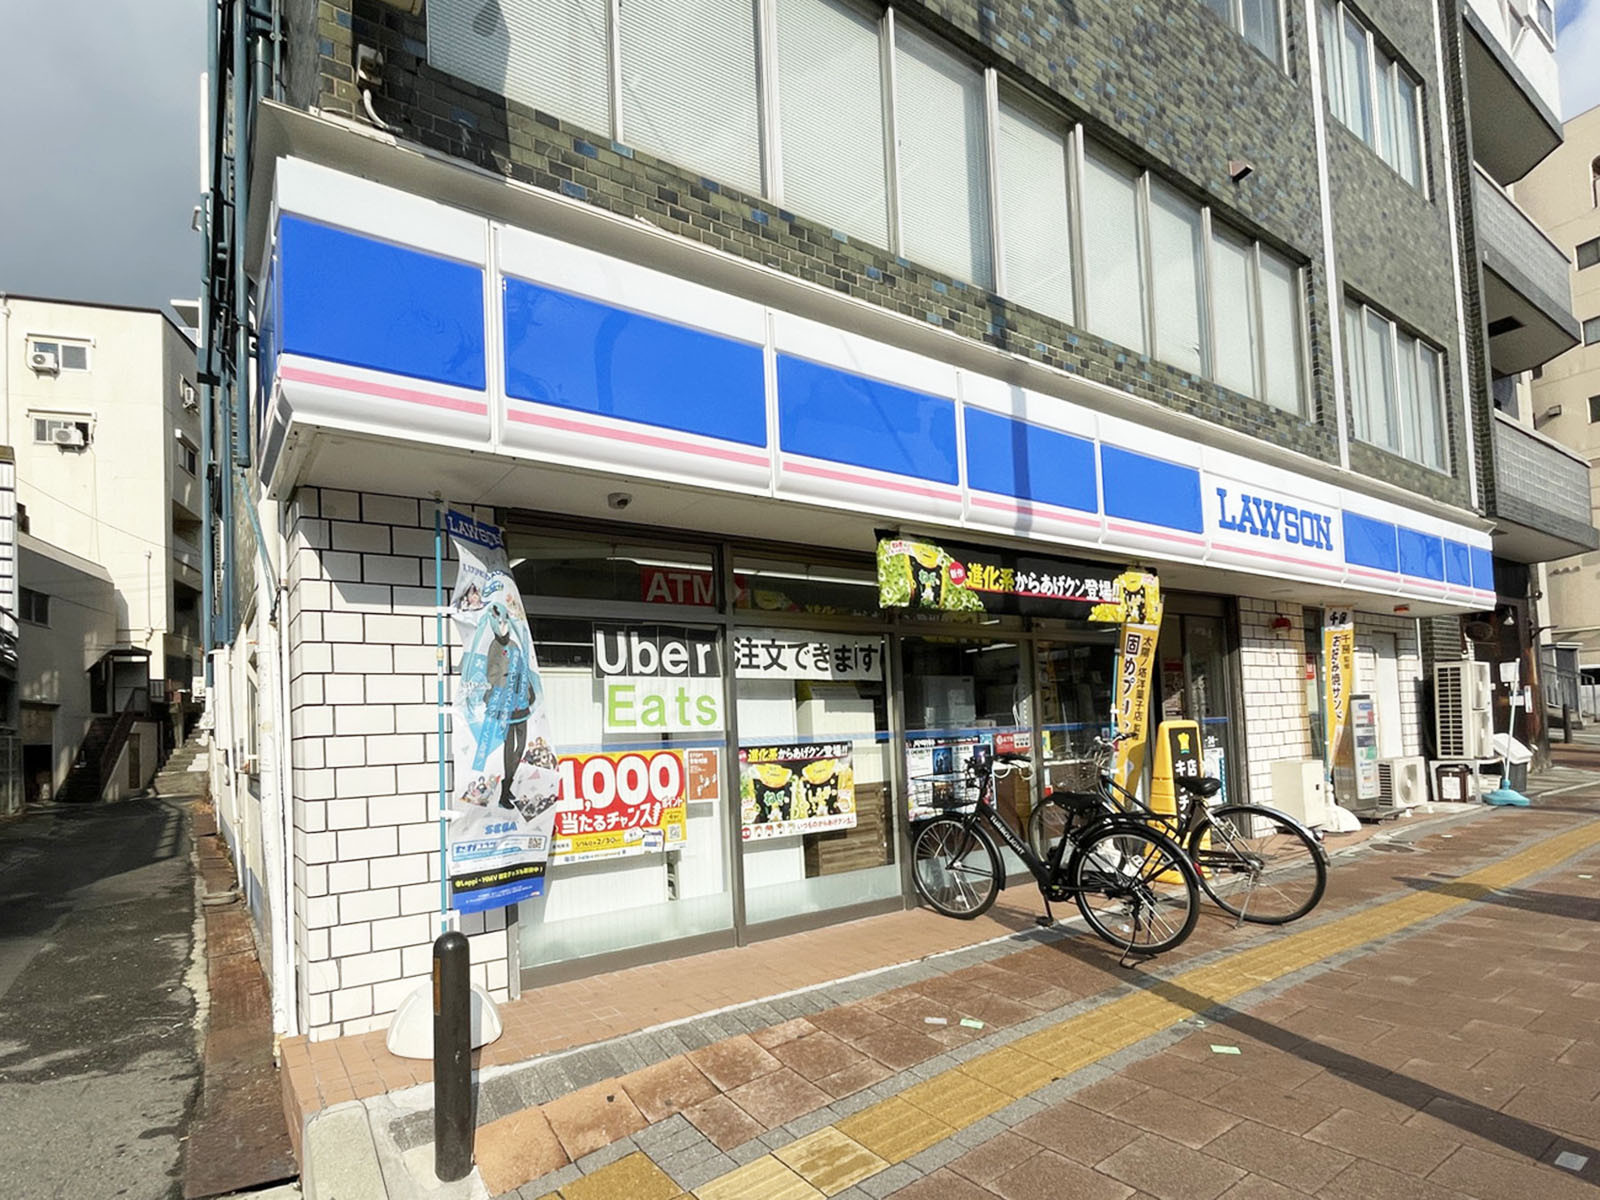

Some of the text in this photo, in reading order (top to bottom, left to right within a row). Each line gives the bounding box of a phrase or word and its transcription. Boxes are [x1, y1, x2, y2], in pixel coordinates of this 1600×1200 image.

[1216, 488, 1333, 551] LAWSON
[646, 571, 714, 604] ATM
[596, 629, 711, 675] Uber
[734, 636, 879, 673] 注文できます
[608, 684, 718, 727] Eats
[556, 753, 681, 812] 1,000
[484, 821, 518, 835] SEGA
